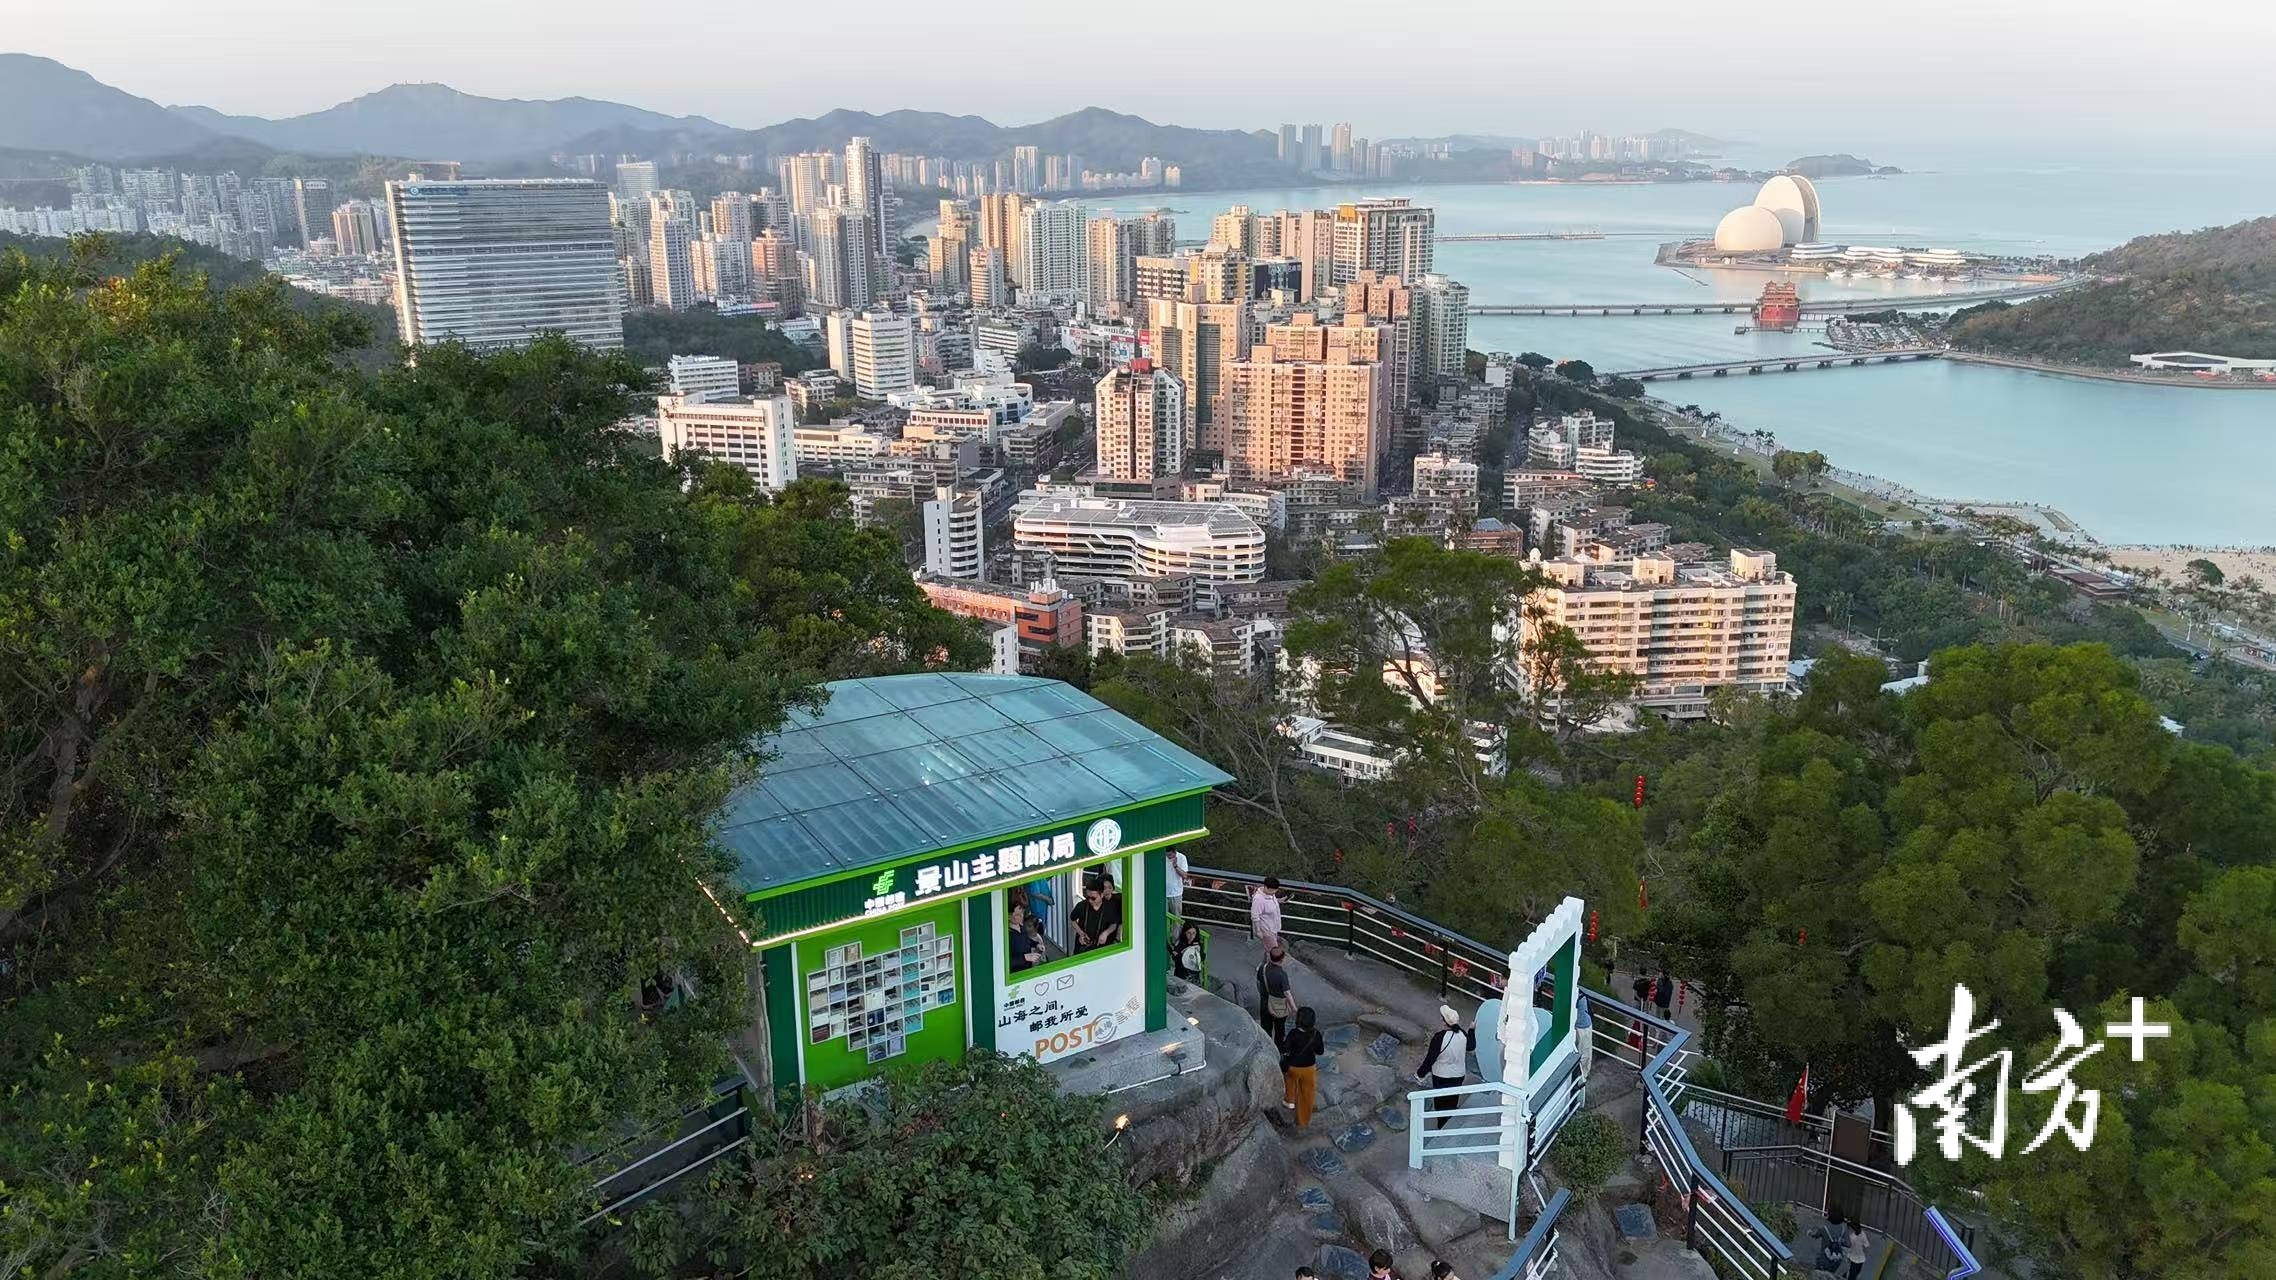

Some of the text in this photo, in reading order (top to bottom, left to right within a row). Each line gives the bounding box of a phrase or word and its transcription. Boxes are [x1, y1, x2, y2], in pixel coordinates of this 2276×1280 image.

[915, 832, 1076, 897] 景山主题邮局
[1029, 1005, 1089, 1033] 邮我所爱
[1035, 1023, 1096, 1059] POST
